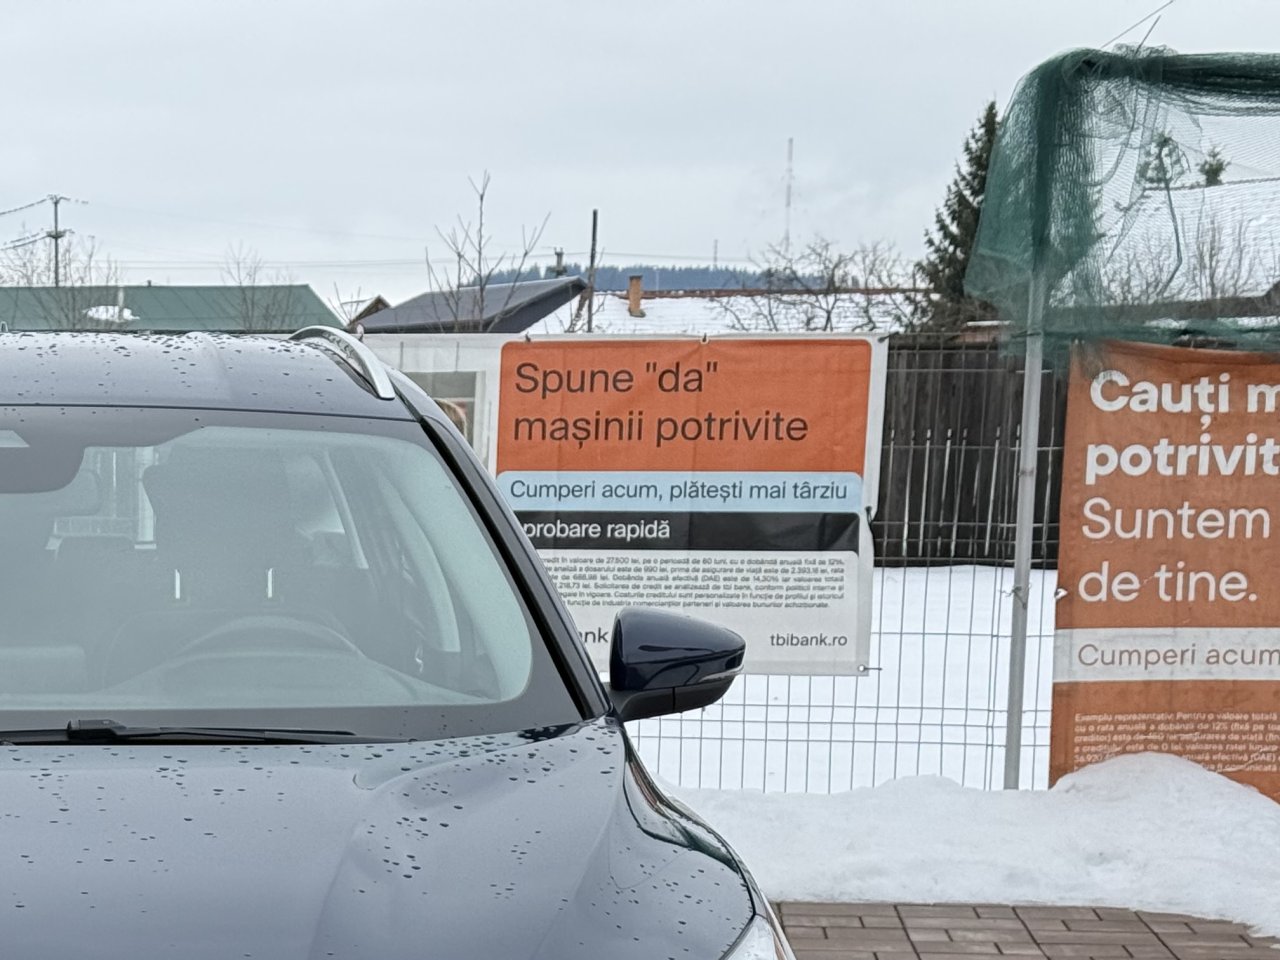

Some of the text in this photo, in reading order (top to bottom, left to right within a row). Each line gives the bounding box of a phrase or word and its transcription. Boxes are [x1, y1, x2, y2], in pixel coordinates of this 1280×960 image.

[515, 361, 718, 400] Spune "da"
[1090, 369, 1230, 430] Cauți
[512, 411, 808, 449] mașinii potrivite
[510, 479, 848, 503] Cumperi acum, plătești mai târziu
[522, 519, 670, 542] probare rapidă
[1081, 497, 1270, 540] Suntem
[1078, 561, 1258, 602] de tine.
[579, 626, 609, 643] nk
[769, 634, 848, 647] tbibank.ro
[1078, 643, 1280, 670] Cumperi acum
